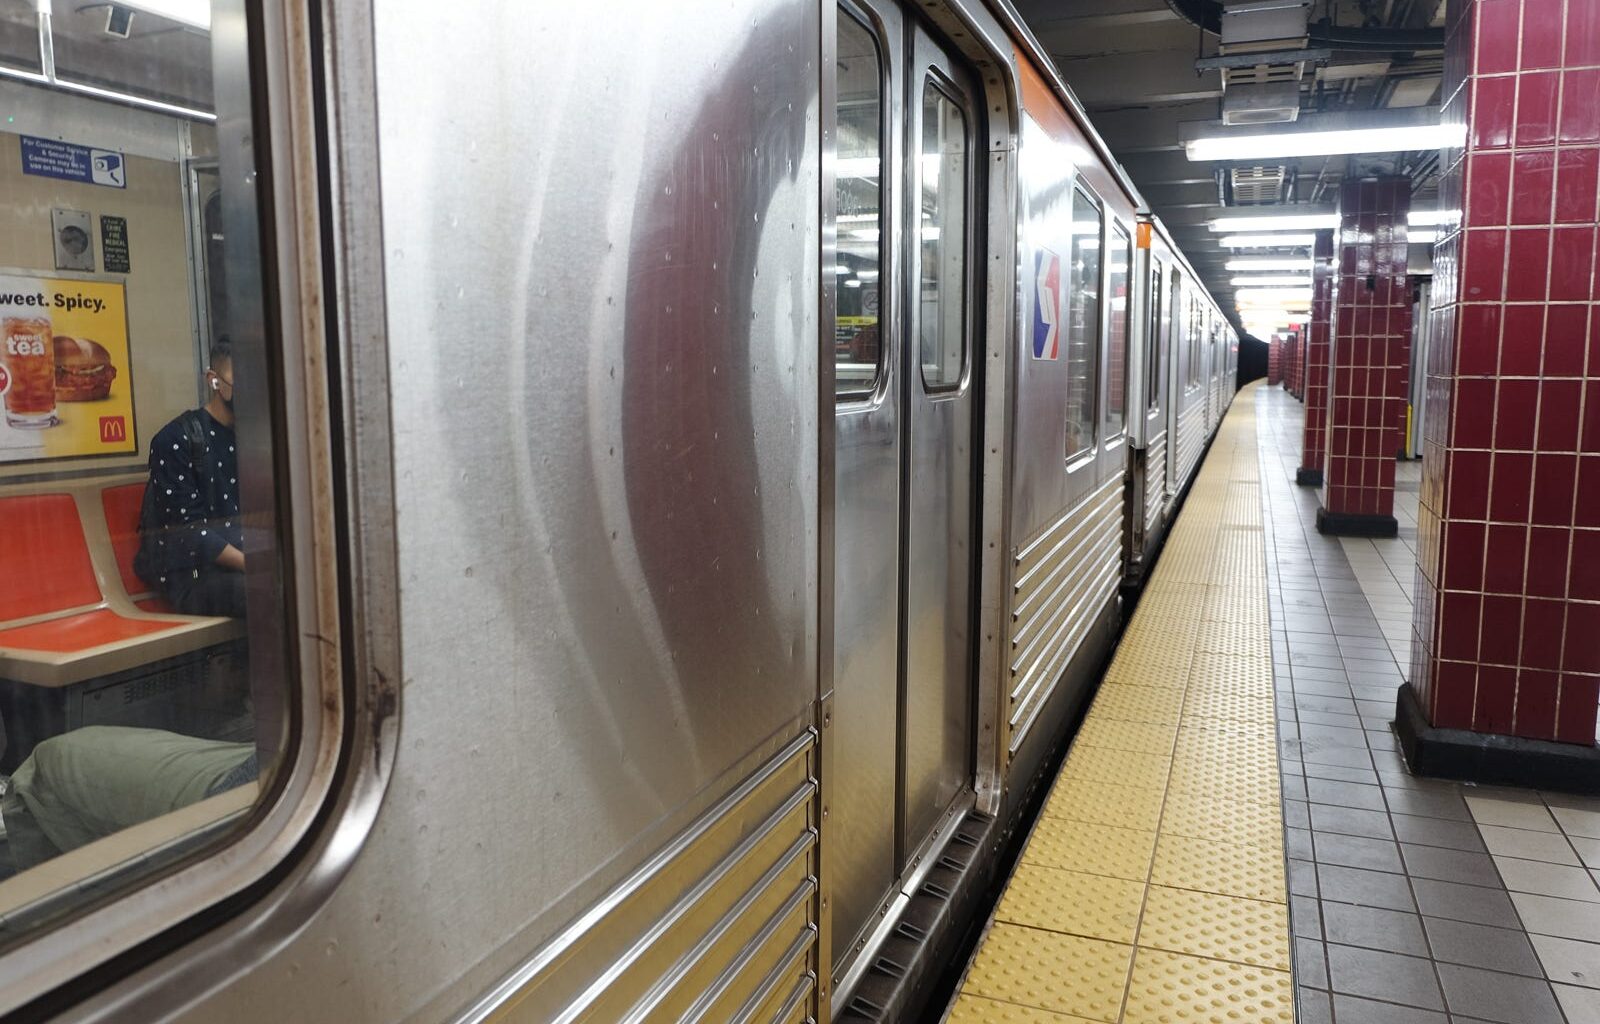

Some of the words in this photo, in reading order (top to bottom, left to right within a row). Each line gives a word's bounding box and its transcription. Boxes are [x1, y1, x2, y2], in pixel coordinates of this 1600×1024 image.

[23, 138, 34, 146] For
[35, 140, 65, 151] Customer
[66, 146, 88, 155] Service
[28, 154, 56, 164] Cameras
[57, 160, 70, 168] may
[65, 168, 86, 176] vehicle
[54, 293, 106, 314] Spicy.
[6, 336, 45, 356] tea
